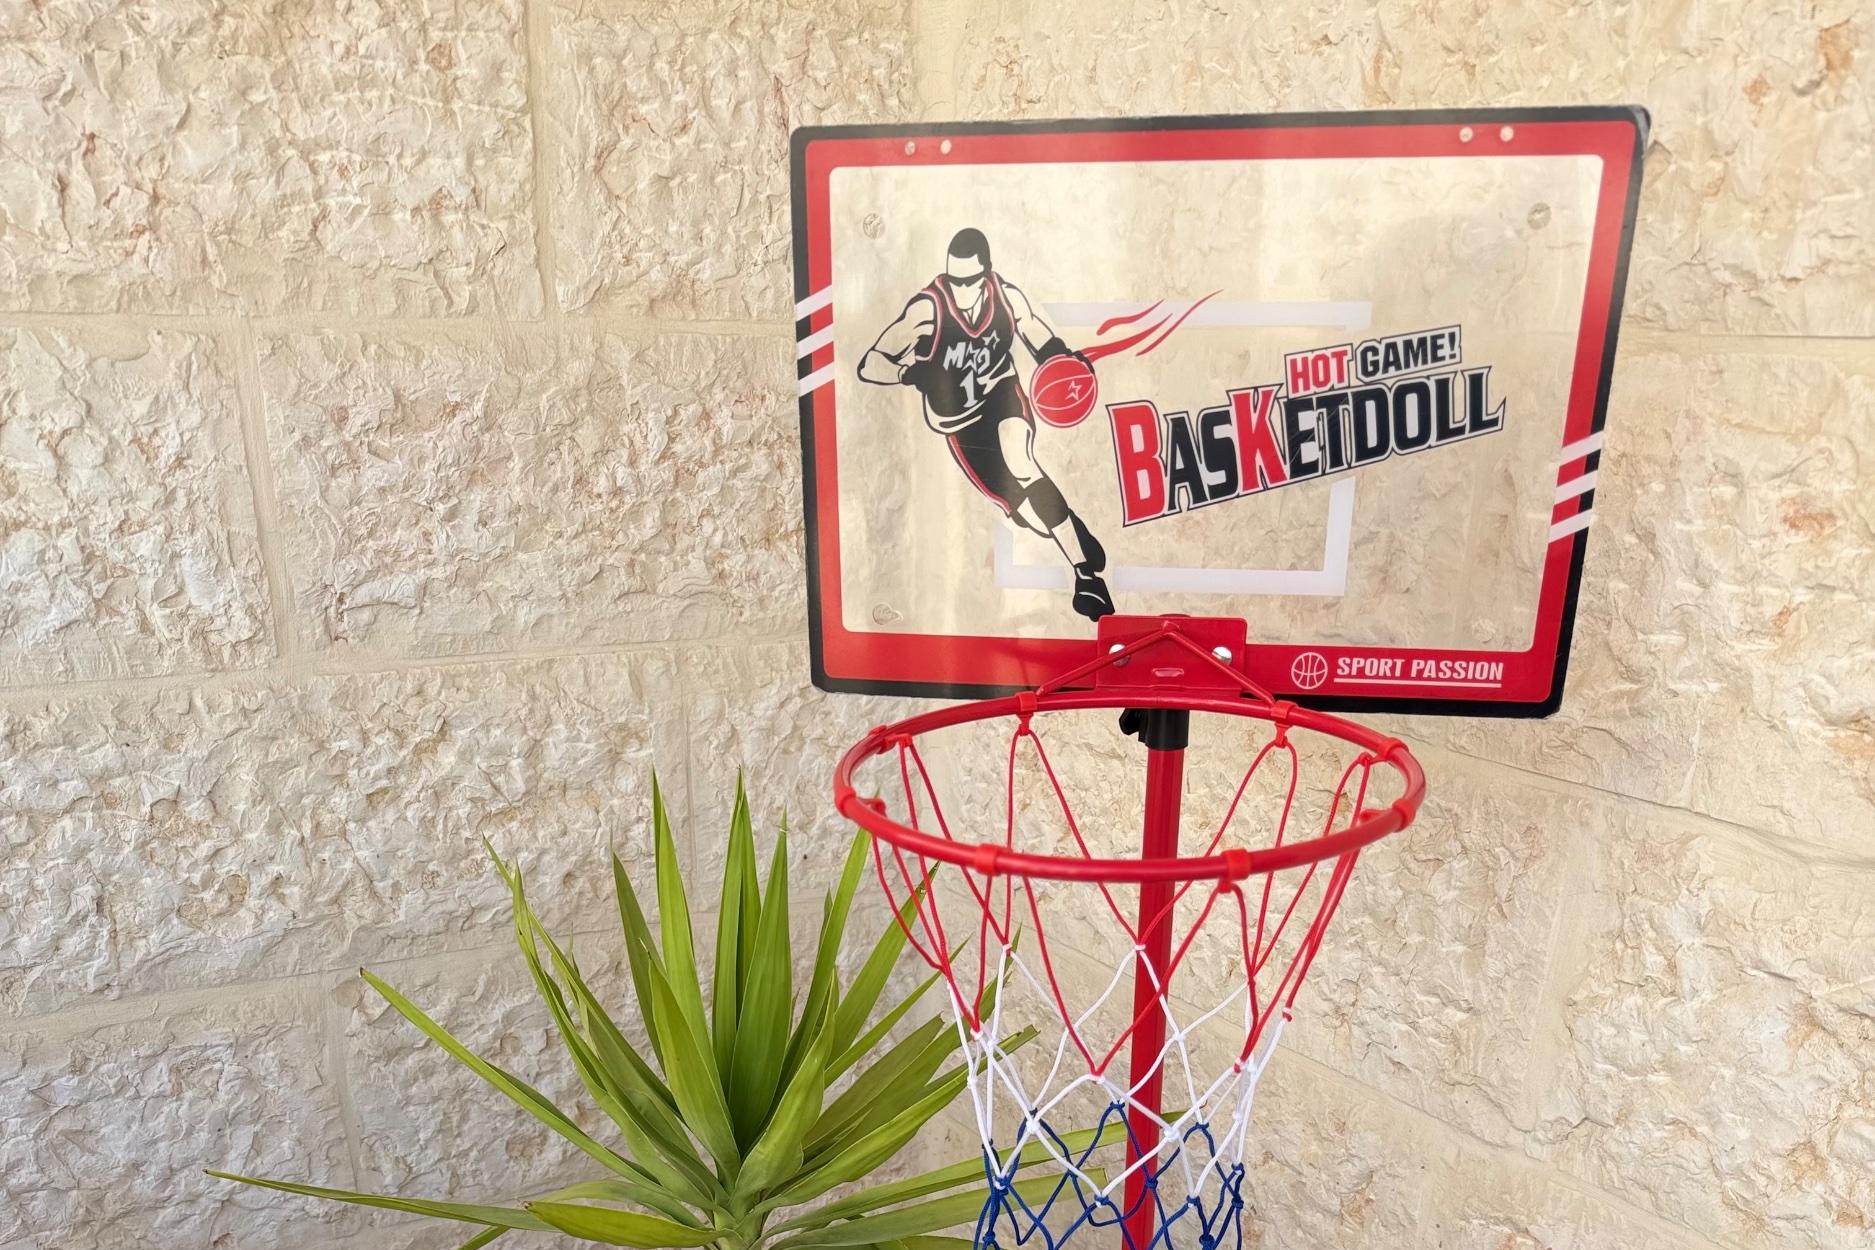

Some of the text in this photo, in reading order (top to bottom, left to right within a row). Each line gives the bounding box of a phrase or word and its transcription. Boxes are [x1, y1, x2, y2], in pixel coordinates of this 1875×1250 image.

[1287, 330, 1459, 396] HOT GAME!
[1108, 368, 1504, 525] BASKETDOLL
[1336, 656, 1504, 681] SPORT PASSION
